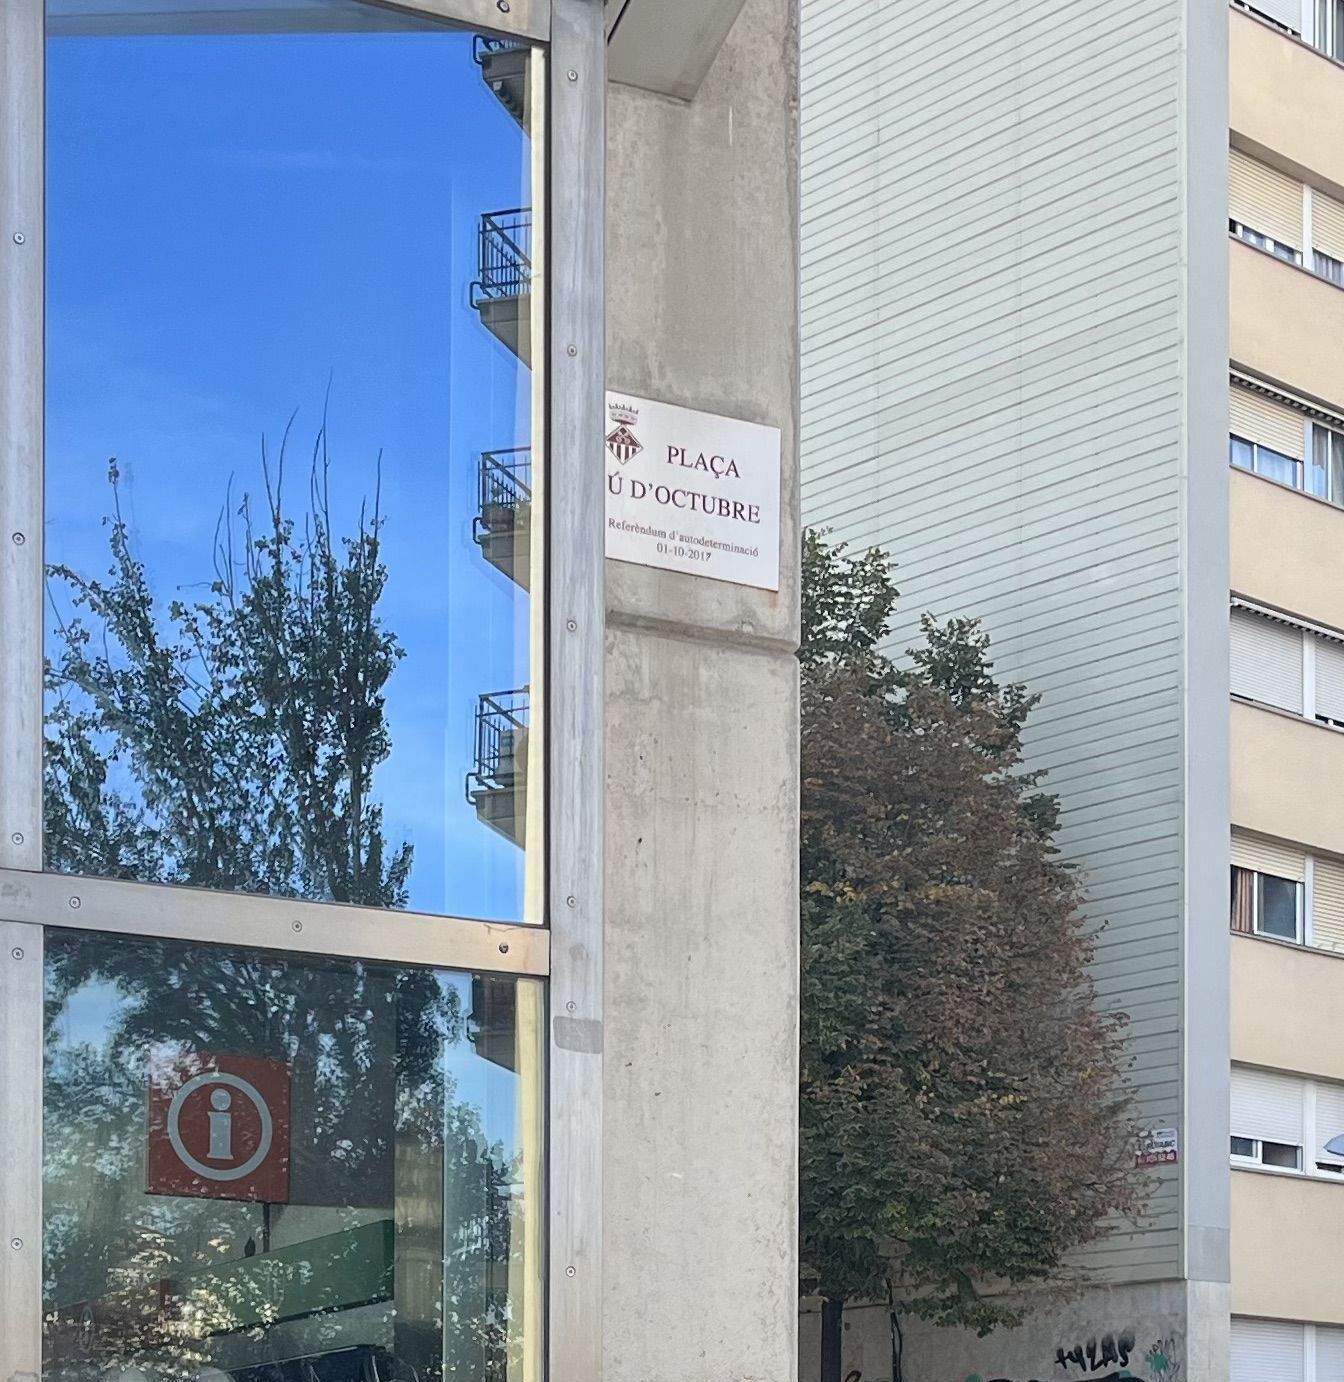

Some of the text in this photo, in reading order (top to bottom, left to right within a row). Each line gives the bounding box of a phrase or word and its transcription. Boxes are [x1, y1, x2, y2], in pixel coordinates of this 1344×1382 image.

[666, 445, 741, 479] PLAÇA
[607, 471, 761, 524] Ú D'OCTUBRE
[608, 518, 759, 558] Referèndum d'autodeterminació
[656, 543, 712, 562] 01-10-2017
